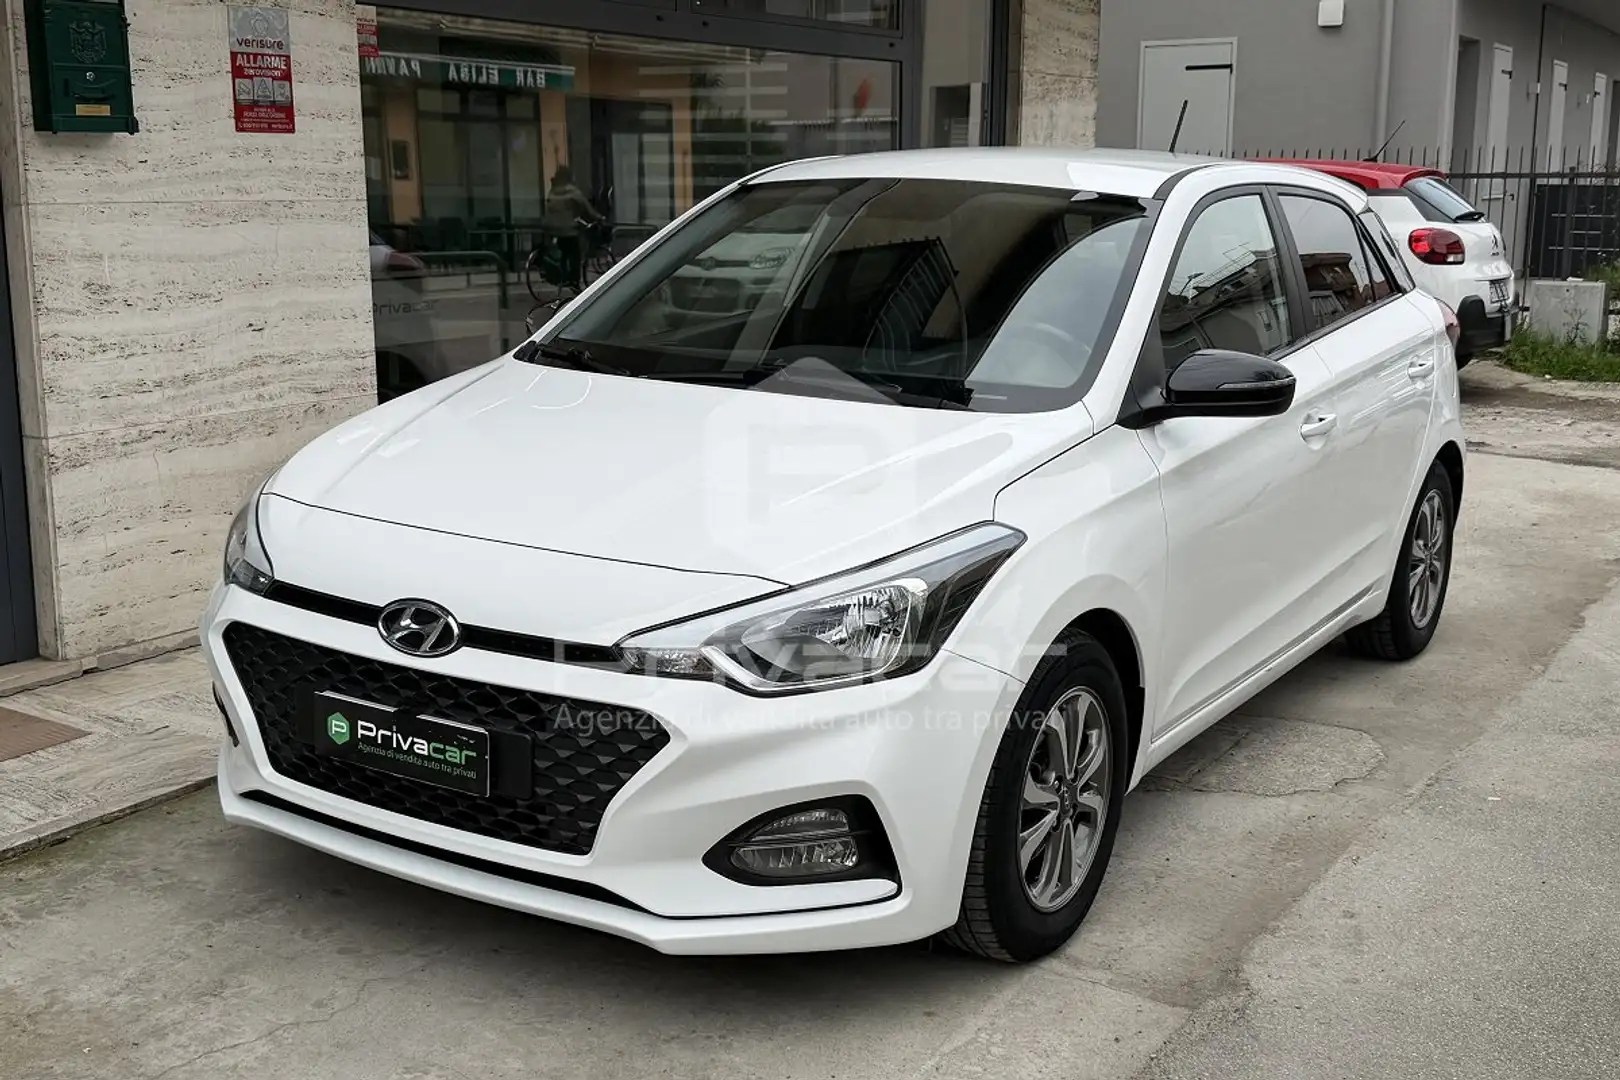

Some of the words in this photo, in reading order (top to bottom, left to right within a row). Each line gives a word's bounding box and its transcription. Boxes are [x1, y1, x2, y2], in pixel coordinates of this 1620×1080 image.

[236, 37, 284, 50] verisure
[236, 53, 287, 69] ALLARME
[357, 719, 477, 765] Privacar
[442, 763, 452, 773] tra
